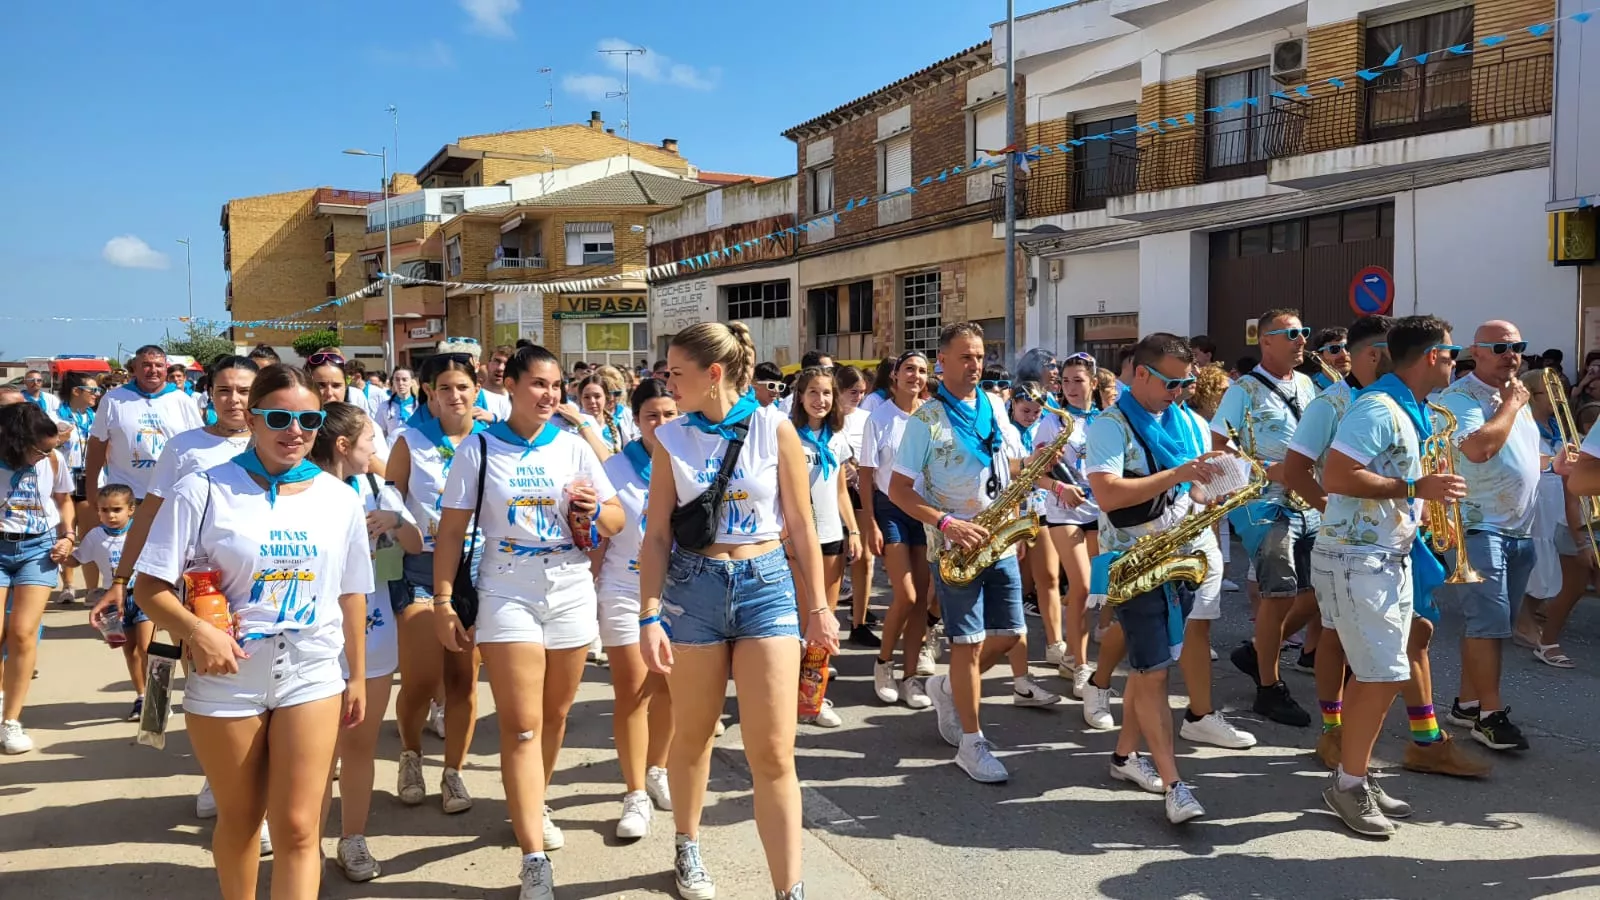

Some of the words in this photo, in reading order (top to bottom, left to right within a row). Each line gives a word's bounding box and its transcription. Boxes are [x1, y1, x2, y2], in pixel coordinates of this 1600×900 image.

[656, 283, 691, 297] COCHES
[694, 280, 707, 291] DE
[567, 297, 647, 312] VIBASA
[660, 292, 702, 306] ALQUILER
[516, 464, 545, 475] PEÑAS
[509, 475, 554, 487] SARIÑENA
[269, 528, 307, 541] PEÑAS
[259, 542, 318, 557] SARIÑENA
